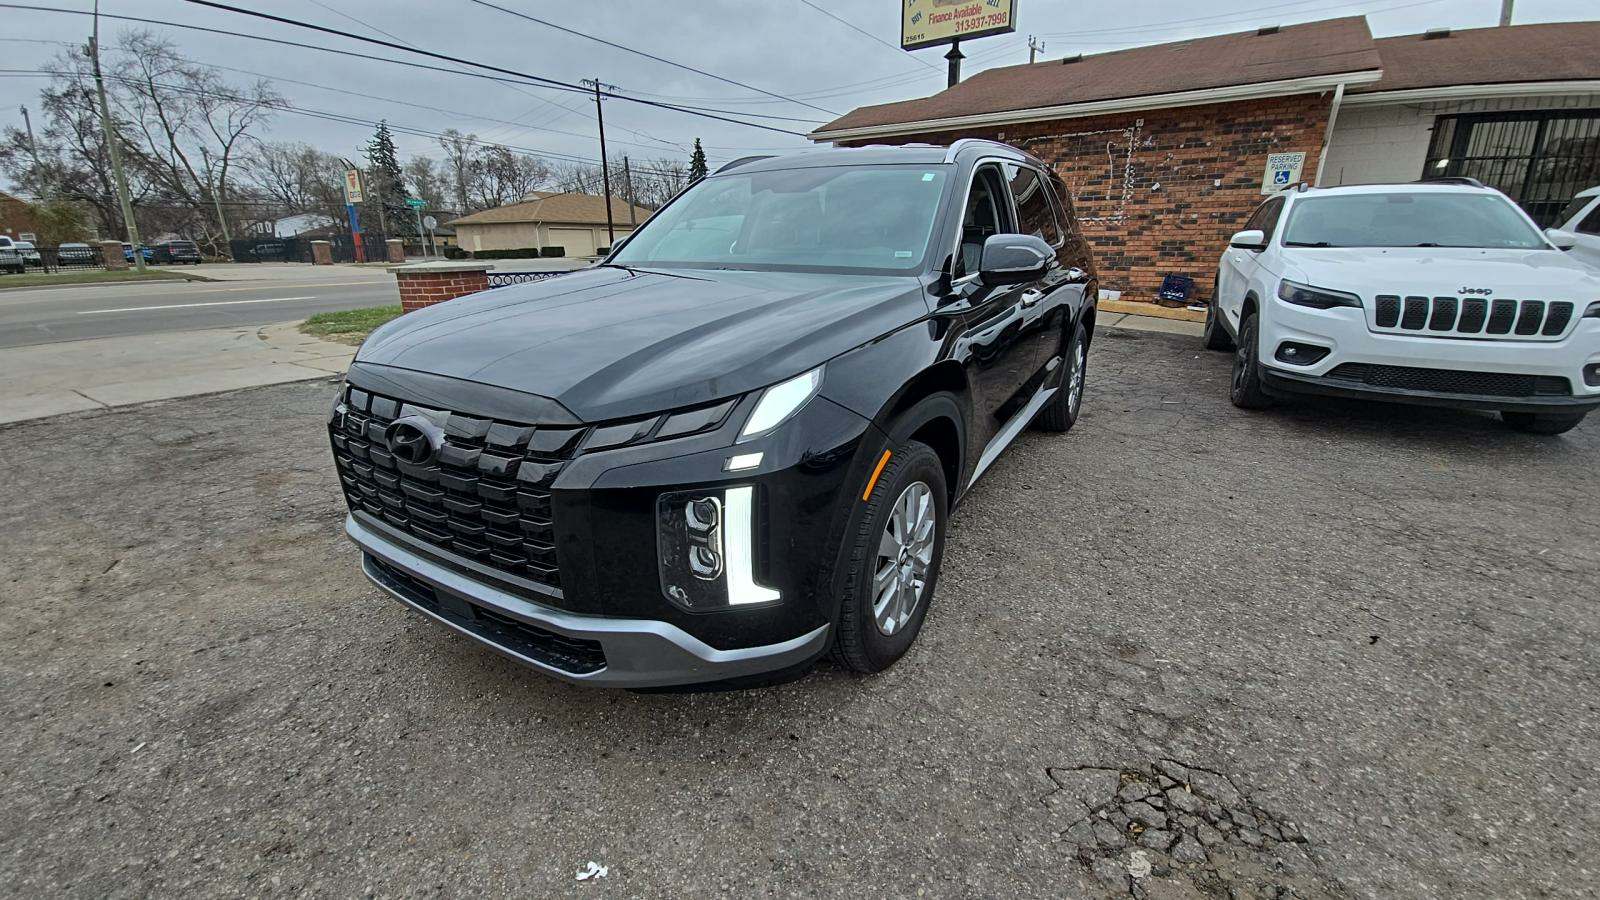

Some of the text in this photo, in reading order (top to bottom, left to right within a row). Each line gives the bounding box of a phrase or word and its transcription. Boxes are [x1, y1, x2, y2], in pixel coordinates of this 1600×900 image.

[928, 4, 982, 25] Finance Available
[955, 11, 1007, 32] 313-937-7998
[905, 33, 925, 43] 25615
[1270, 154, 1302, 163] RESERVED
[1271, 162, 1298, 170] PARKING
[1457, 286, 1493, 296] Jeep
